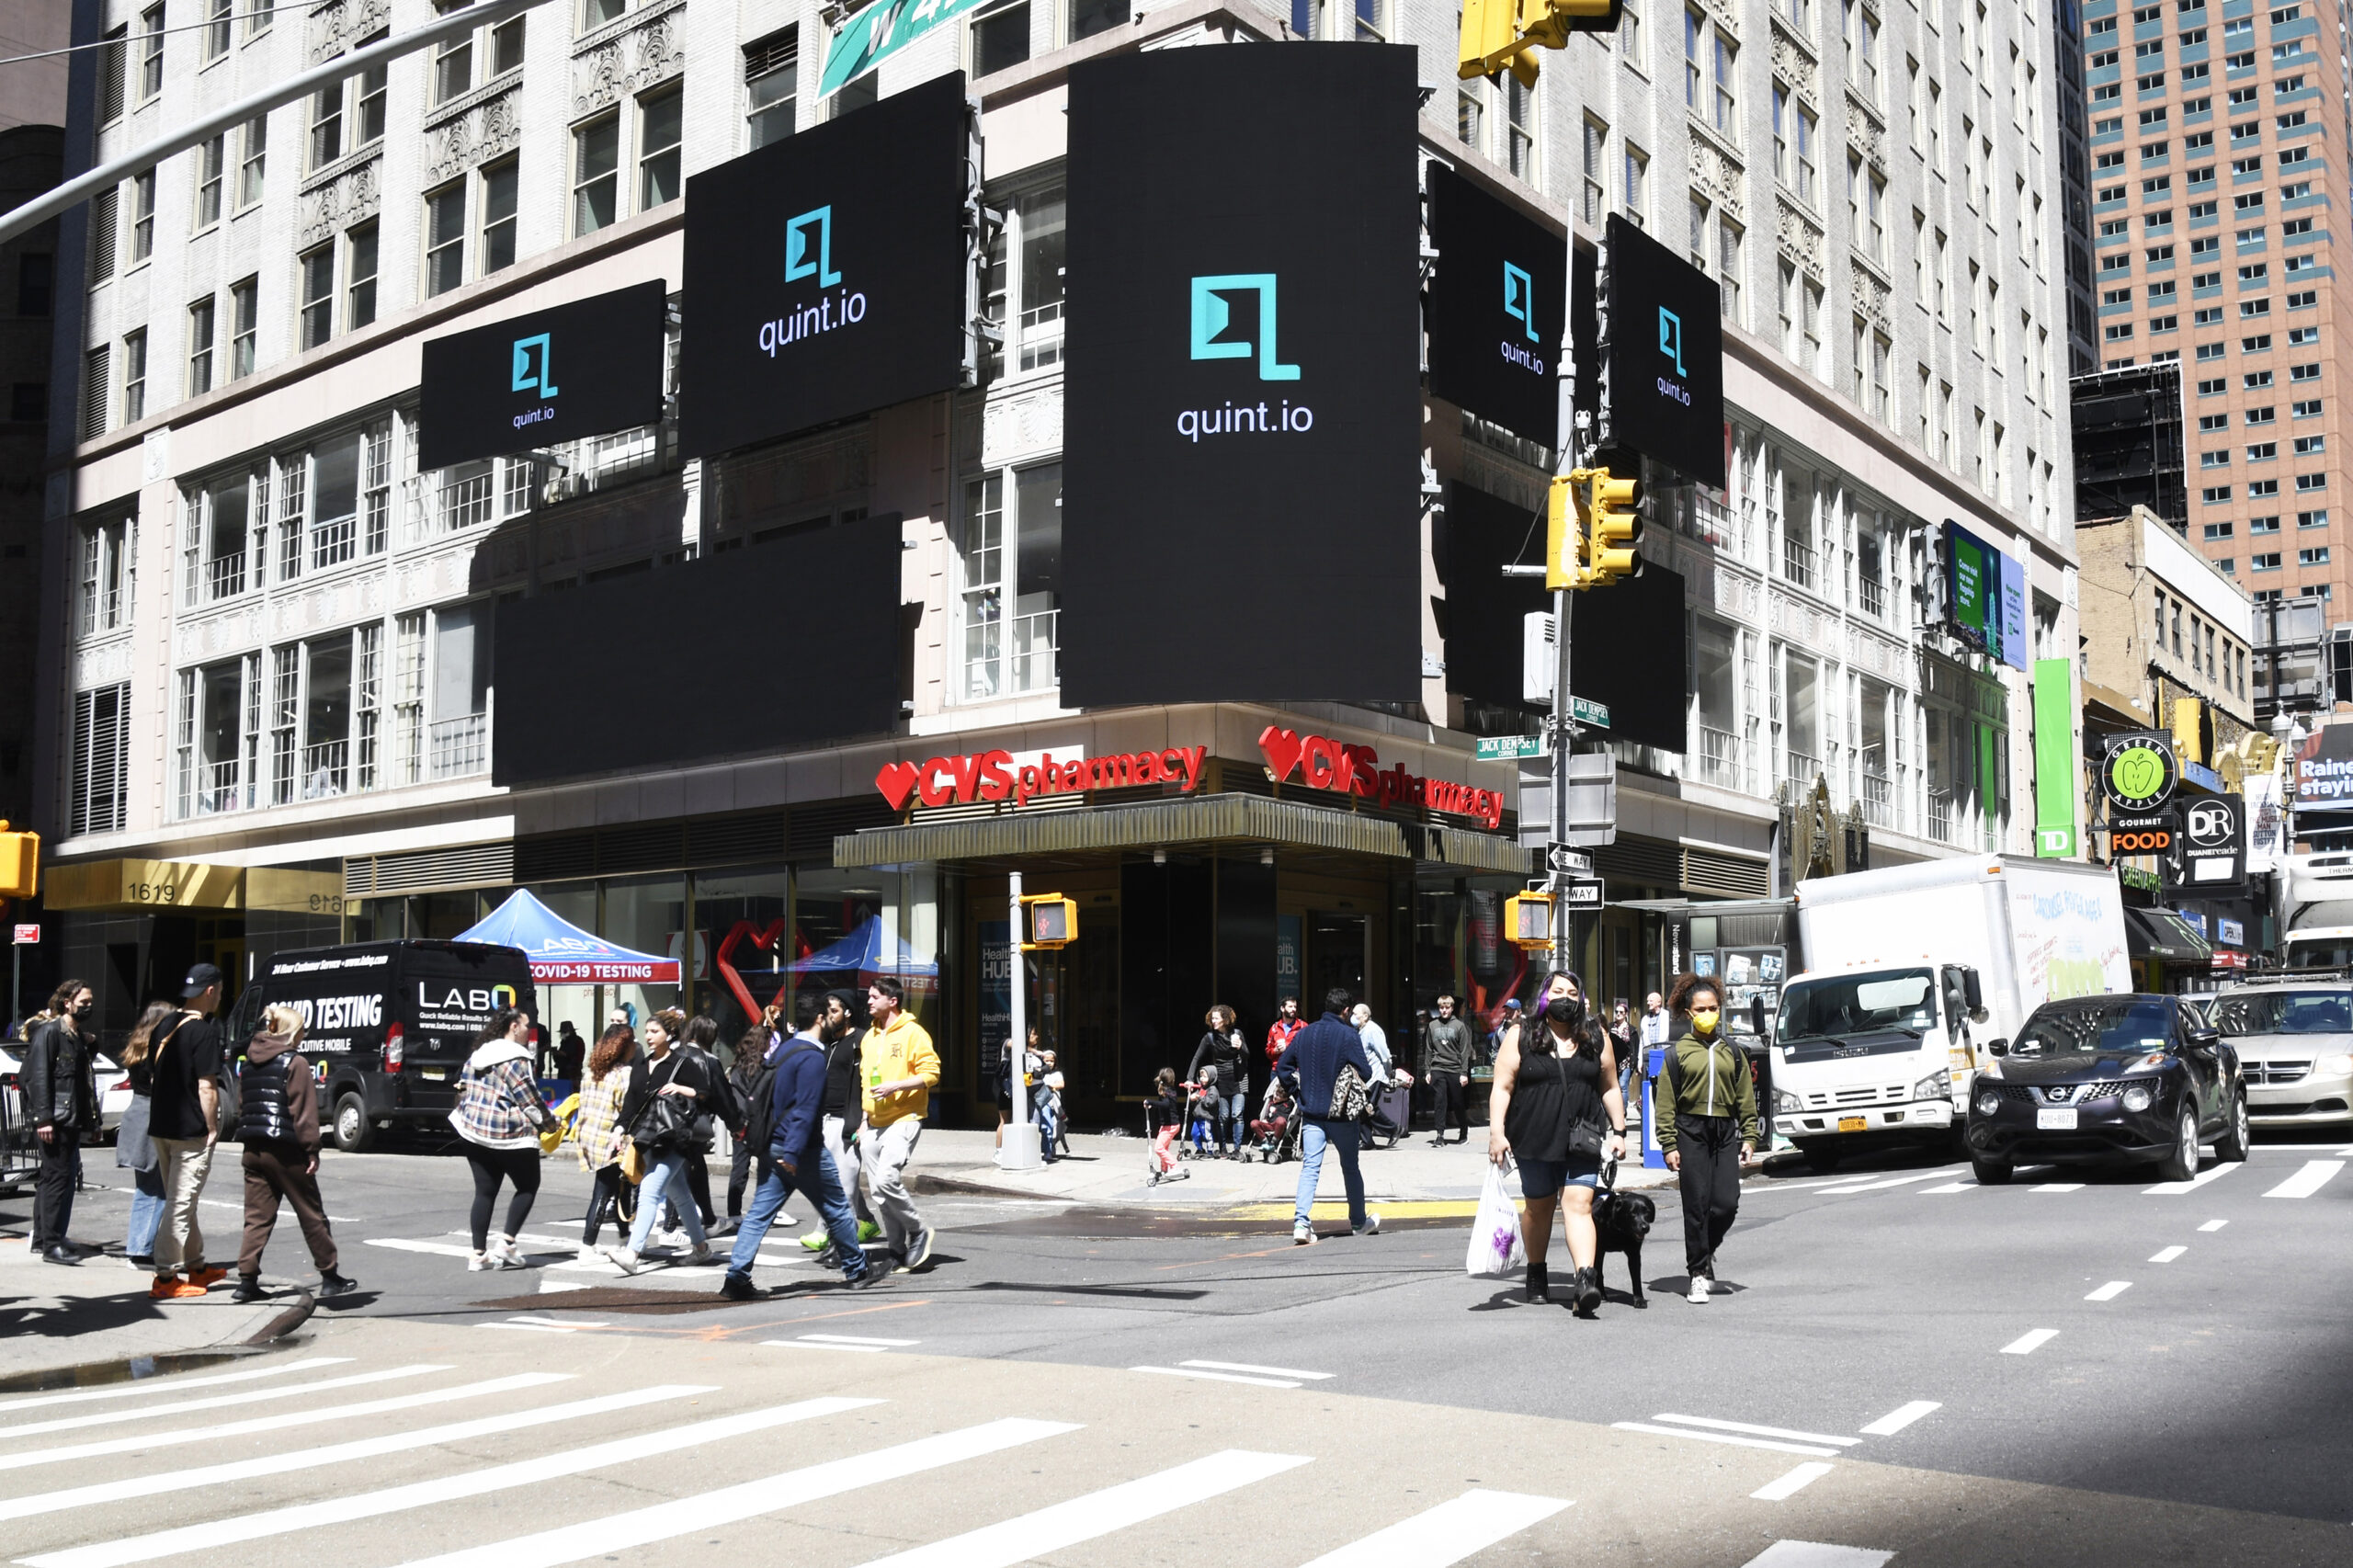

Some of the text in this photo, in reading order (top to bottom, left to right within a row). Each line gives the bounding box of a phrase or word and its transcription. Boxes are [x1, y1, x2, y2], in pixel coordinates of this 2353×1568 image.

[868, 1, 902, 57] W
[759, 288, 867, 358] quint.io
[1501, 339, 1544, 376] quint.io
[1657, 376, 1691, 407] quint.io
[513, 405, 555, 430] quint.io
[1176, 400, 1313, 443] quint.io
[1575, 699, 1608, 721] JACK DEMPSEY
[1479, 736, 1538, 753] JACK DEMPSEY
[1497, 749, 1518, 757] CORNER
[2112, 739, 2165, 759] GREEN
[919, 745, 1208, 807] CVS pharmacy
[1301, 735, 1504, 829] CVS pharmacy
[2114, 791, 2164, 808] APPLE
[2119, 817, 2163, 827] GOURMET
[2188, 809, 2234, 837] DR
[2040, 830, 2068, 851] TD
[2112, 832, 2170, 851] FOOD
[2253, 830, 2277, 838] SUTTON
[1554, 852, 1588, 868] ONE WAY
[2122, 866, 2162, 894] GREEN APPLE
[128, 882, 176, 902] 1619
[1571, 890, 1594, 900] WAY
[1672, 924, 1681, 975] Newsstand
[272, 964, 280, 975] 24
[279, 963, 295, 974] Hour
[294, 961, 322, 972] Customer
[320, 960, 342, 971] Service
[595, 964, 652, 979] TESTING
[419, 982, 517, 1011] LABQ
[316, 994, 383, 1030] TESTING
[419, 1012, 437, 1020] Quick
[437, 1013, 461, 1021] Reliable
[461, 1014, 483, 1023] Results
[419, 1021, 466, 1032] www.labq.com
[324, 1038, 352, 1051] MOBILE
[1833, 1046, 1870, 1059] ISUZU
